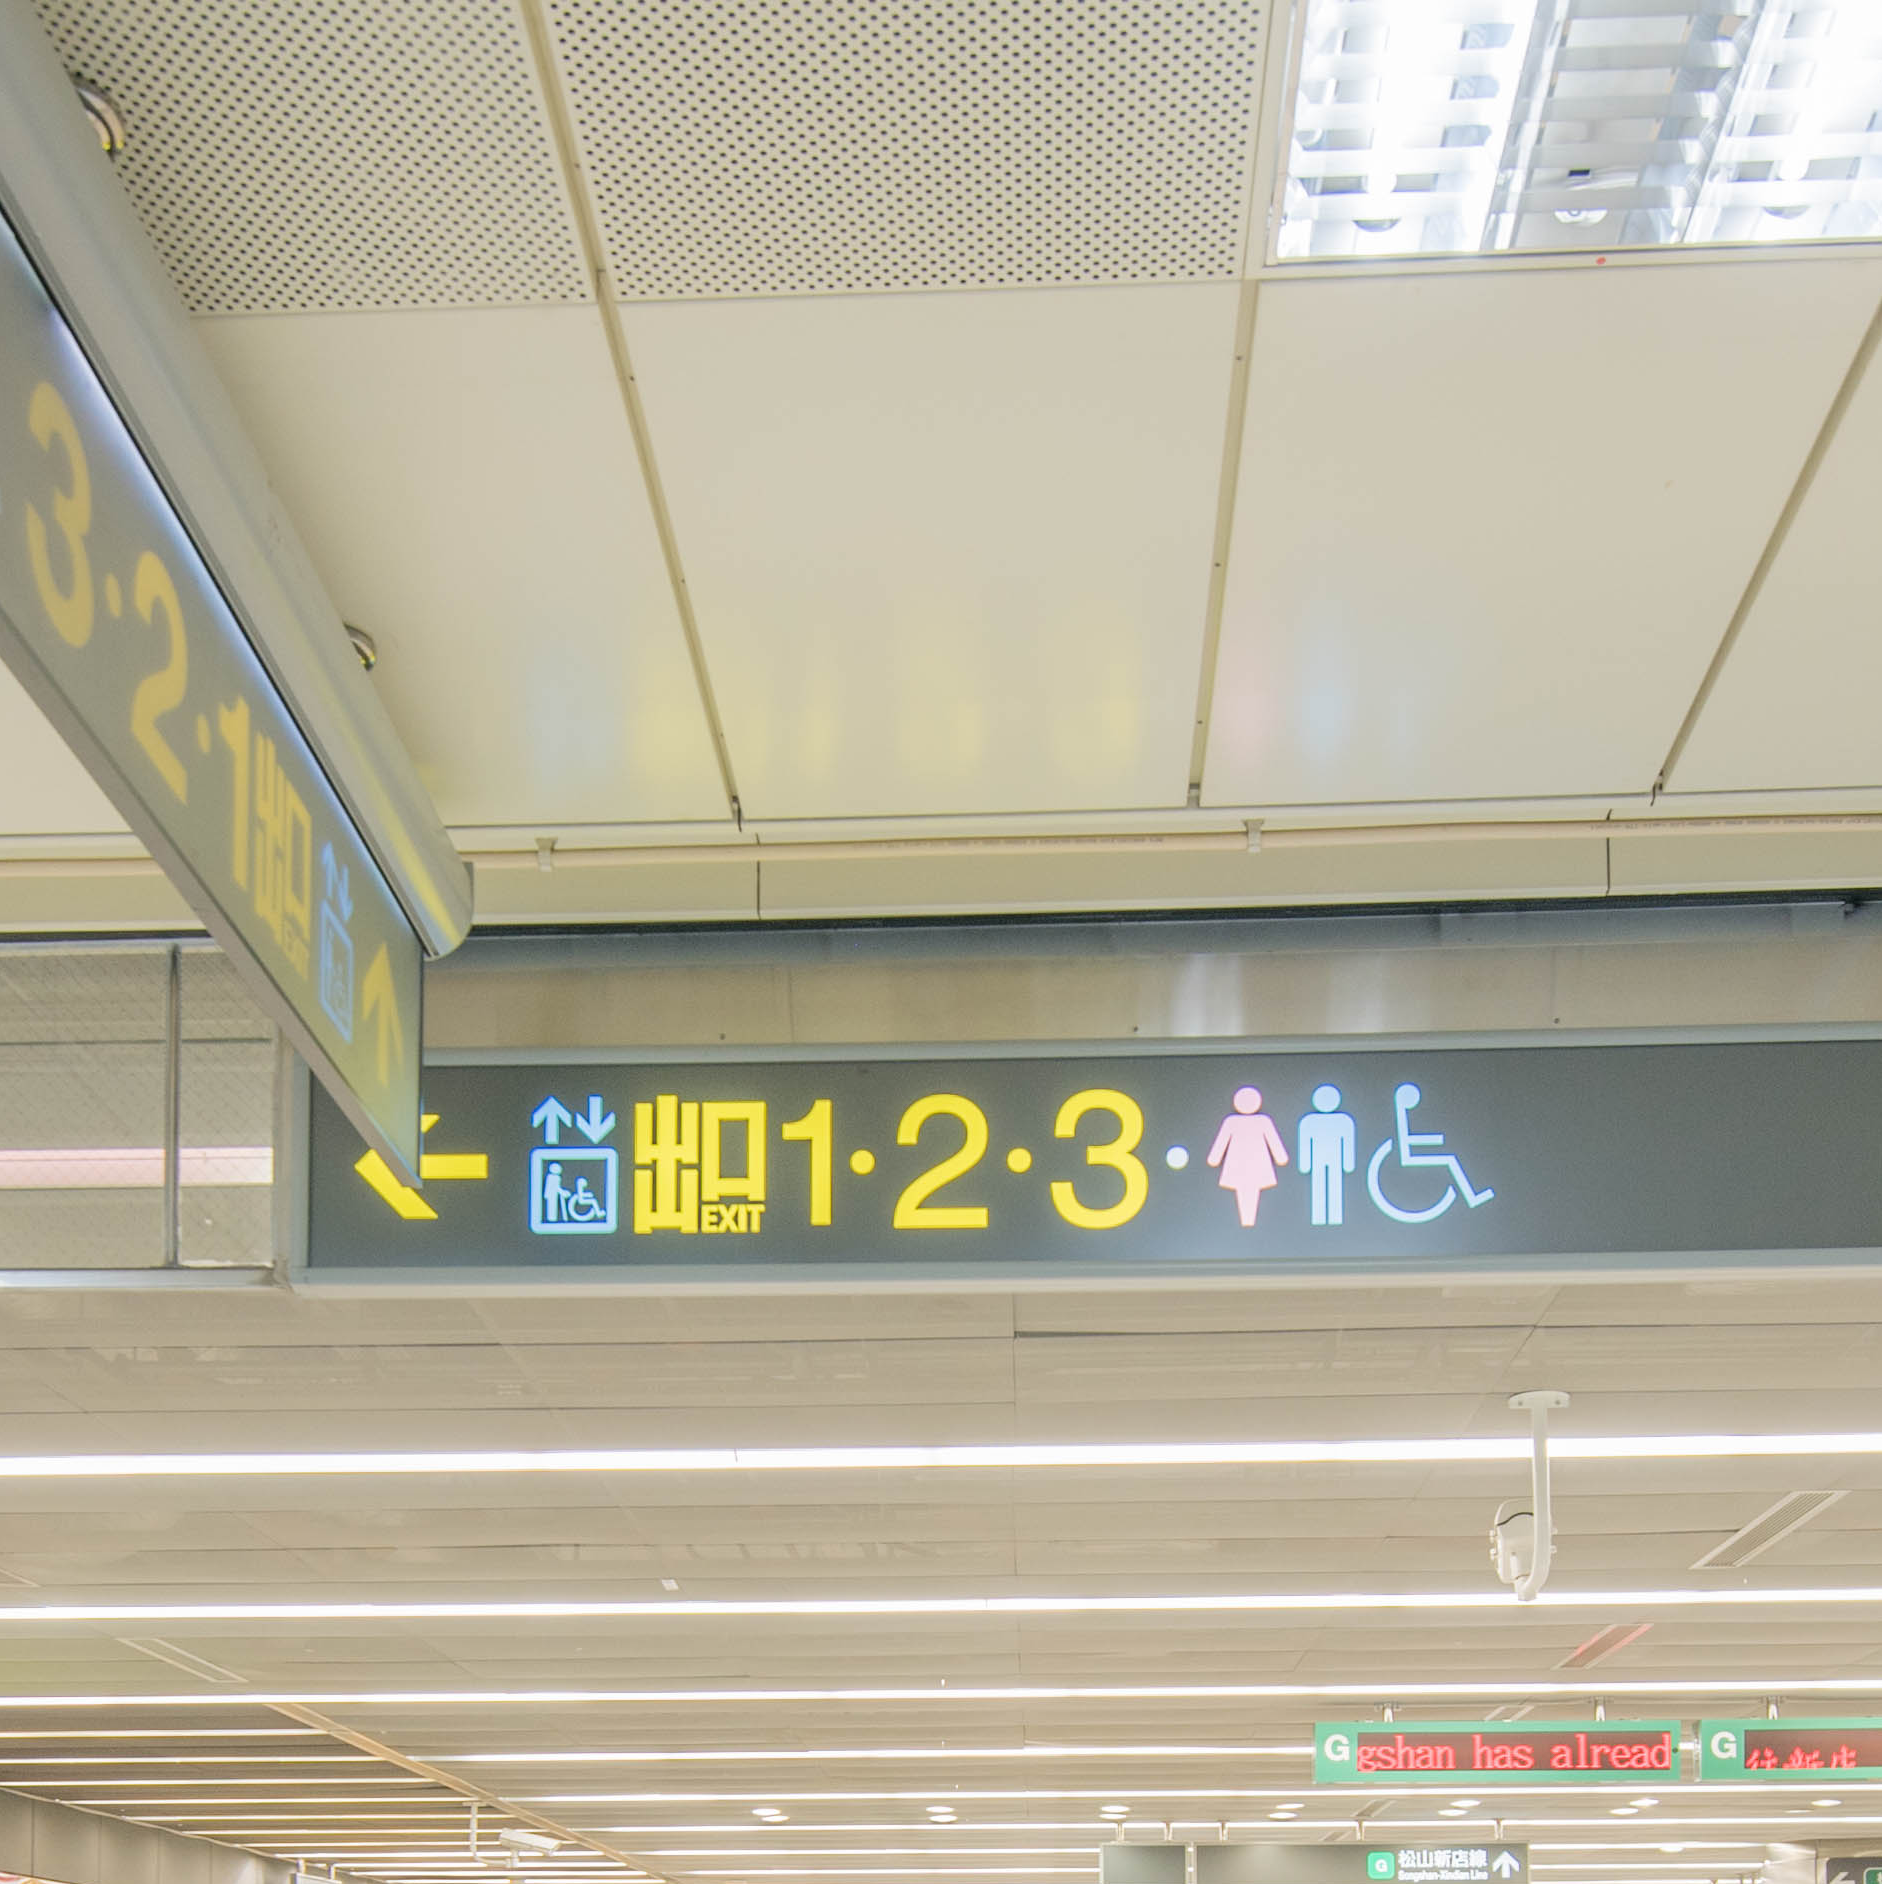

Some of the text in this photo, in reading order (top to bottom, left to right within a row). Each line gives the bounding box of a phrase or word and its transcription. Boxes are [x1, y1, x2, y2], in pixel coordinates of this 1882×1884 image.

[633, 1094, 767, 1235] 出口
[700, 1203, 766, 1235] EXIT
[1324, 1734, 1350, 1762] G
[1356, 1731, 1672, 1773] gshan has alread
[1710, 1731, 1737, 1759] G
[1398, 1848, 1489, 1868] 松山新店線
